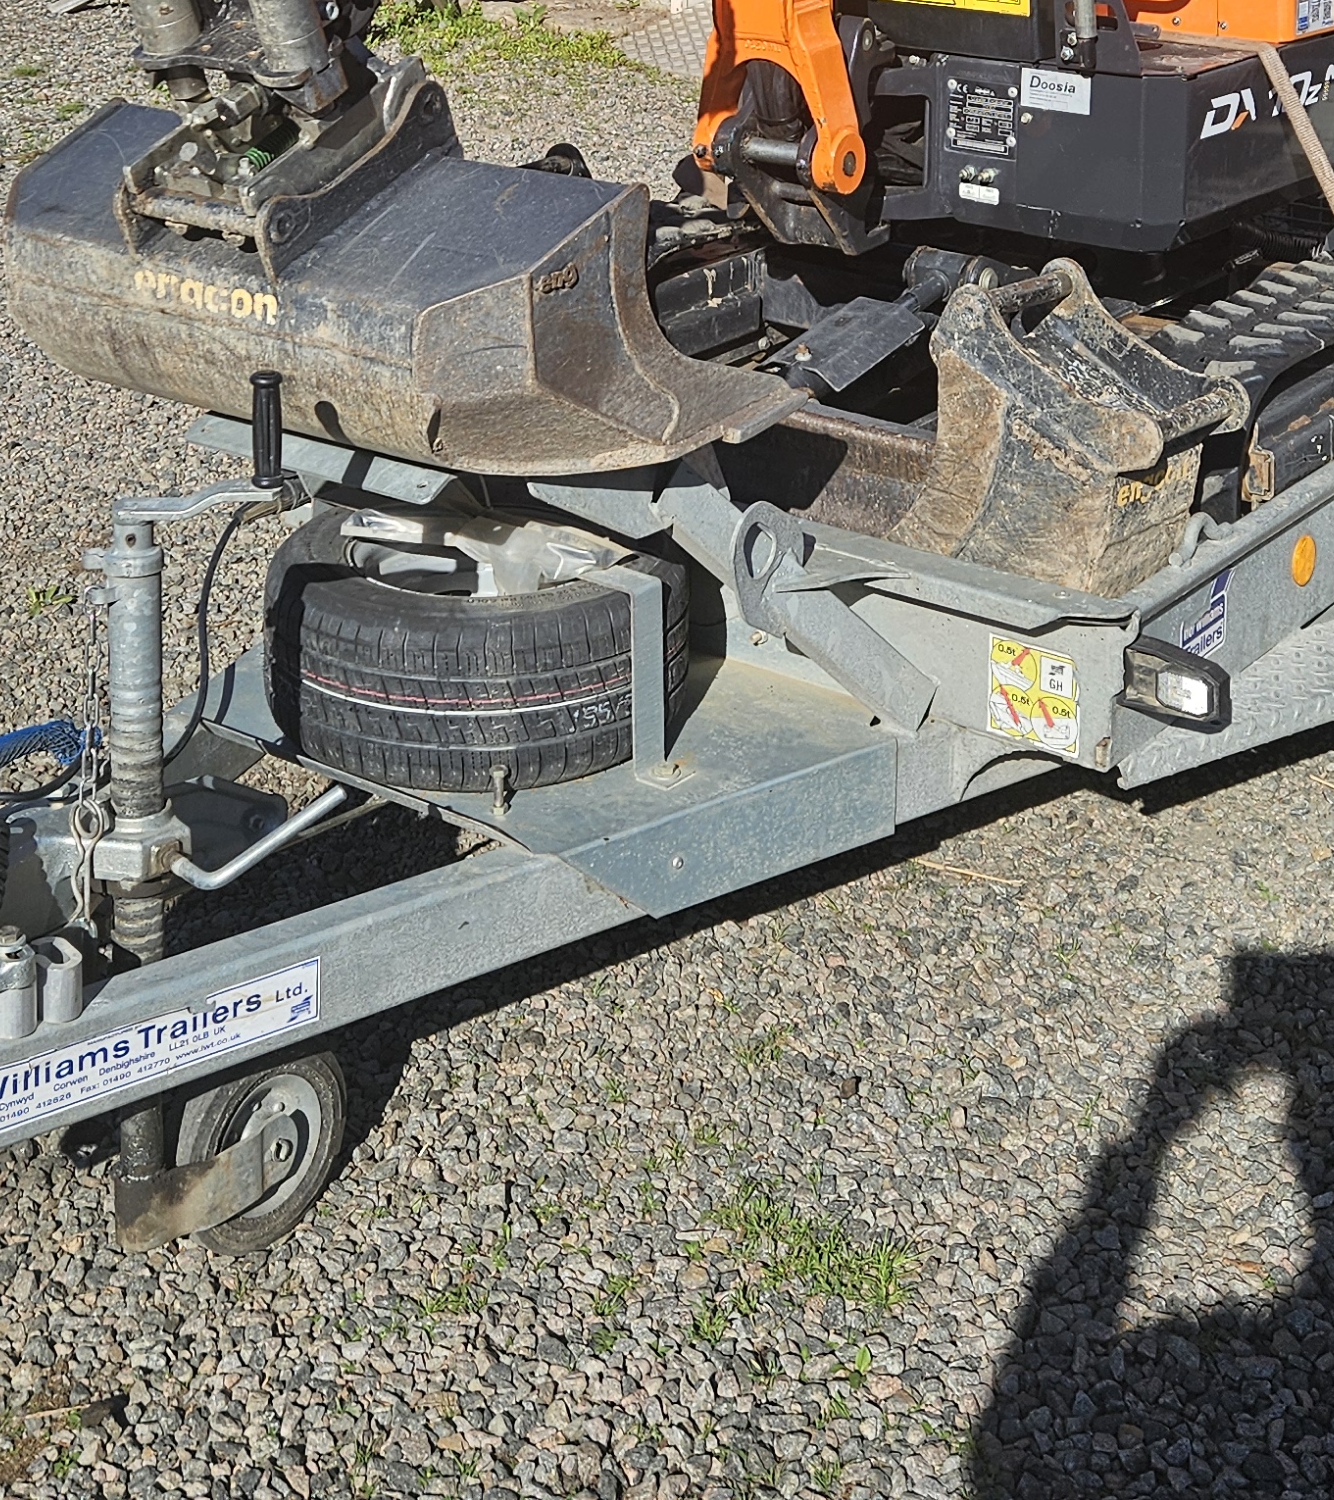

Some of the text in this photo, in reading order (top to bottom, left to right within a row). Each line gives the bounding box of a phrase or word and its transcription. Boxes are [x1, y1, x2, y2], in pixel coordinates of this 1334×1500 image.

[1030, 75, 1076, 94] Doosia
[997, 643, 1016, 657] 0.5t
[1049, 678, 1063, 692] GH
[1011, 693, 1031, 706] 0.5t
[1052, 705, 1071, 719] 0.5t
[137, 993, 262, 1049] Trailers
[275, 981, 308, 1003] Ltd.
[53, 1075, 89, 1092] Corwen
[98, 1051, 156, 1077] Denbighshire
[168, 1038, 190, 1052] LL21
[213, 1025, 227, 1036] UK
[0, 1106, 30, 1123] 01490
[79, 1082, 100, 1095] Fax:
[102, 1070, 132, 1087] 01490
[137, 1057, 171, 1074] 412770
